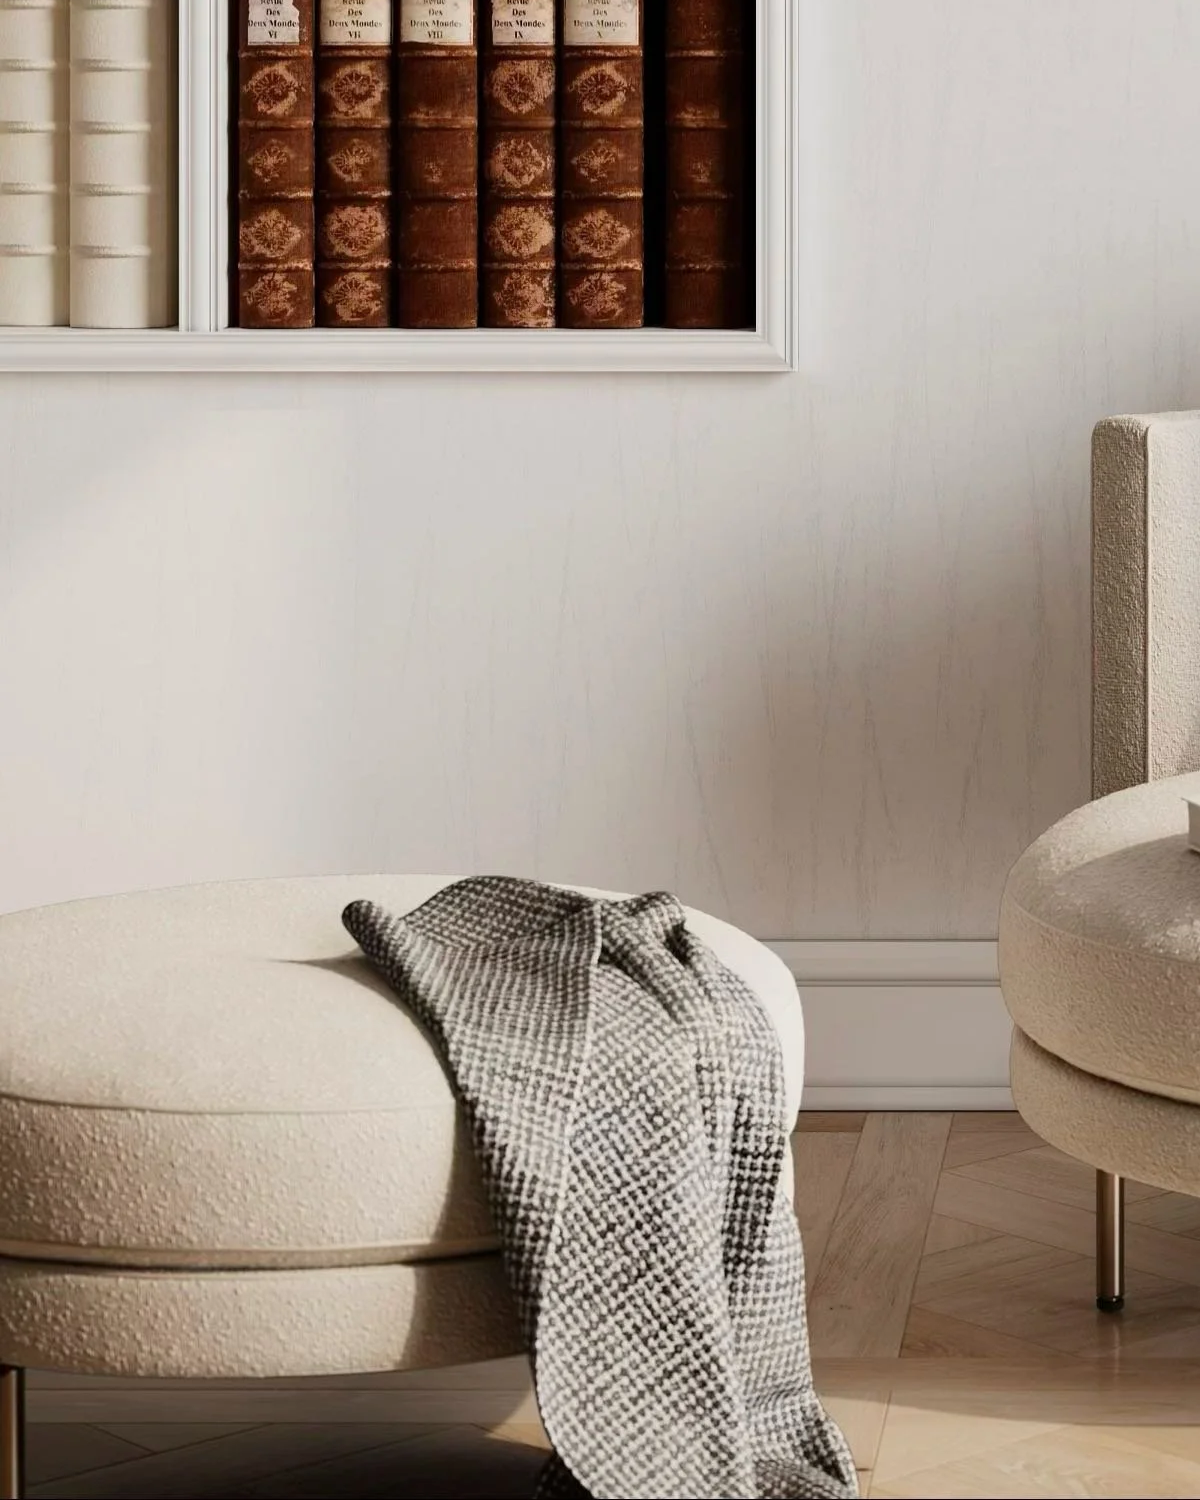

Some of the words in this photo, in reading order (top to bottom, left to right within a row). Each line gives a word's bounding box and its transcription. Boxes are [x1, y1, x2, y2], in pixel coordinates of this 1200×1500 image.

[266, 8, 280, 16] Des
[347, 8, 363, 16] Des
[428, 8, 443, 16] Des
[512, 8, 527, 16] Des
[592, 8, 608, 16] Des
[329, 20, 348, 28] Deux
[410, 20, 429, 28] Deux
[494, 20, 513, 28] Deux
[515, 20, 546, 28] Mondes
[268, 31, 277, 39] VI
[427, 31, 443, 39] VIII
[514, 31, 524, 39] IX
